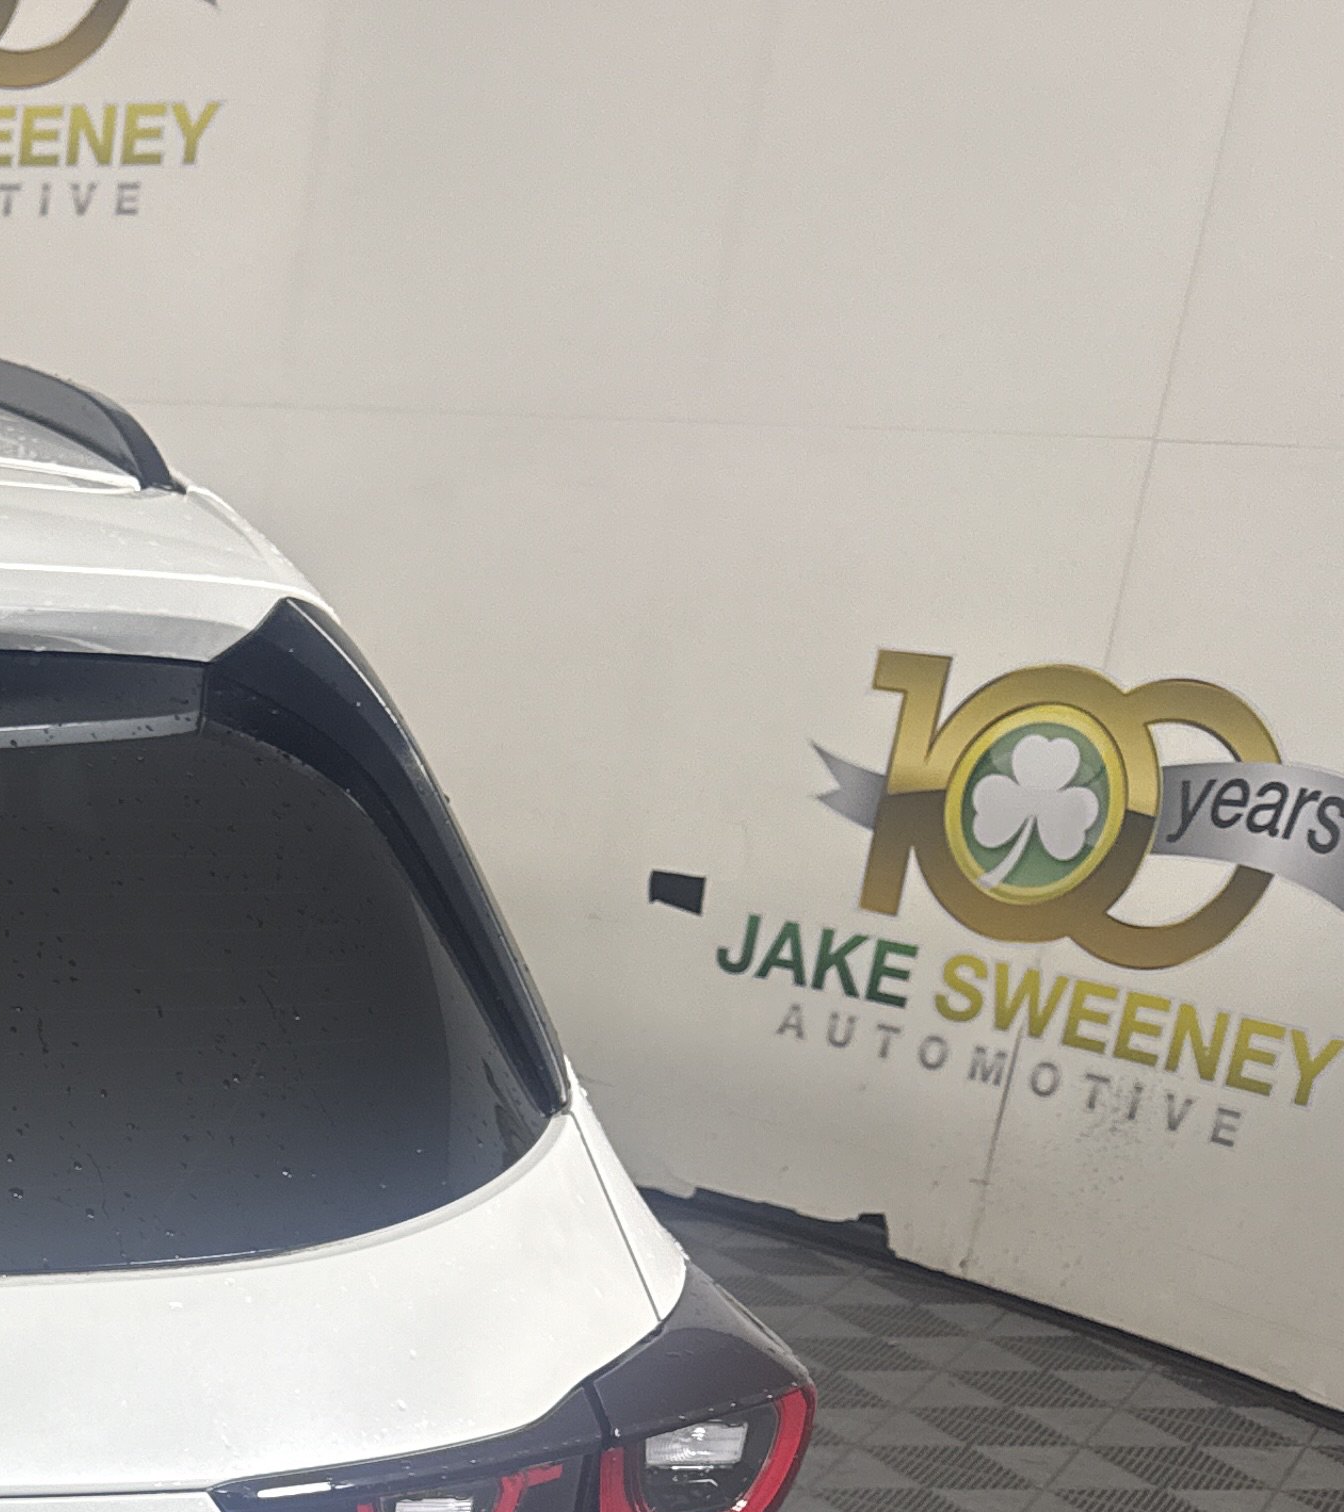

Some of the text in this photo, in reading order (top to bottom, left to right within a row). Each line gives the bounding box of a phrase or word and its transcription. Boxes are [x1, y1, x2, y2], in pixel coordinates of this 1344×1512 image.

[1165, 777, 1344, 854] years
[716, 914, 1344, 1107] JAKE SWEENEY
[777, 1003, 1242, 1148] AUTOMOTIVE
